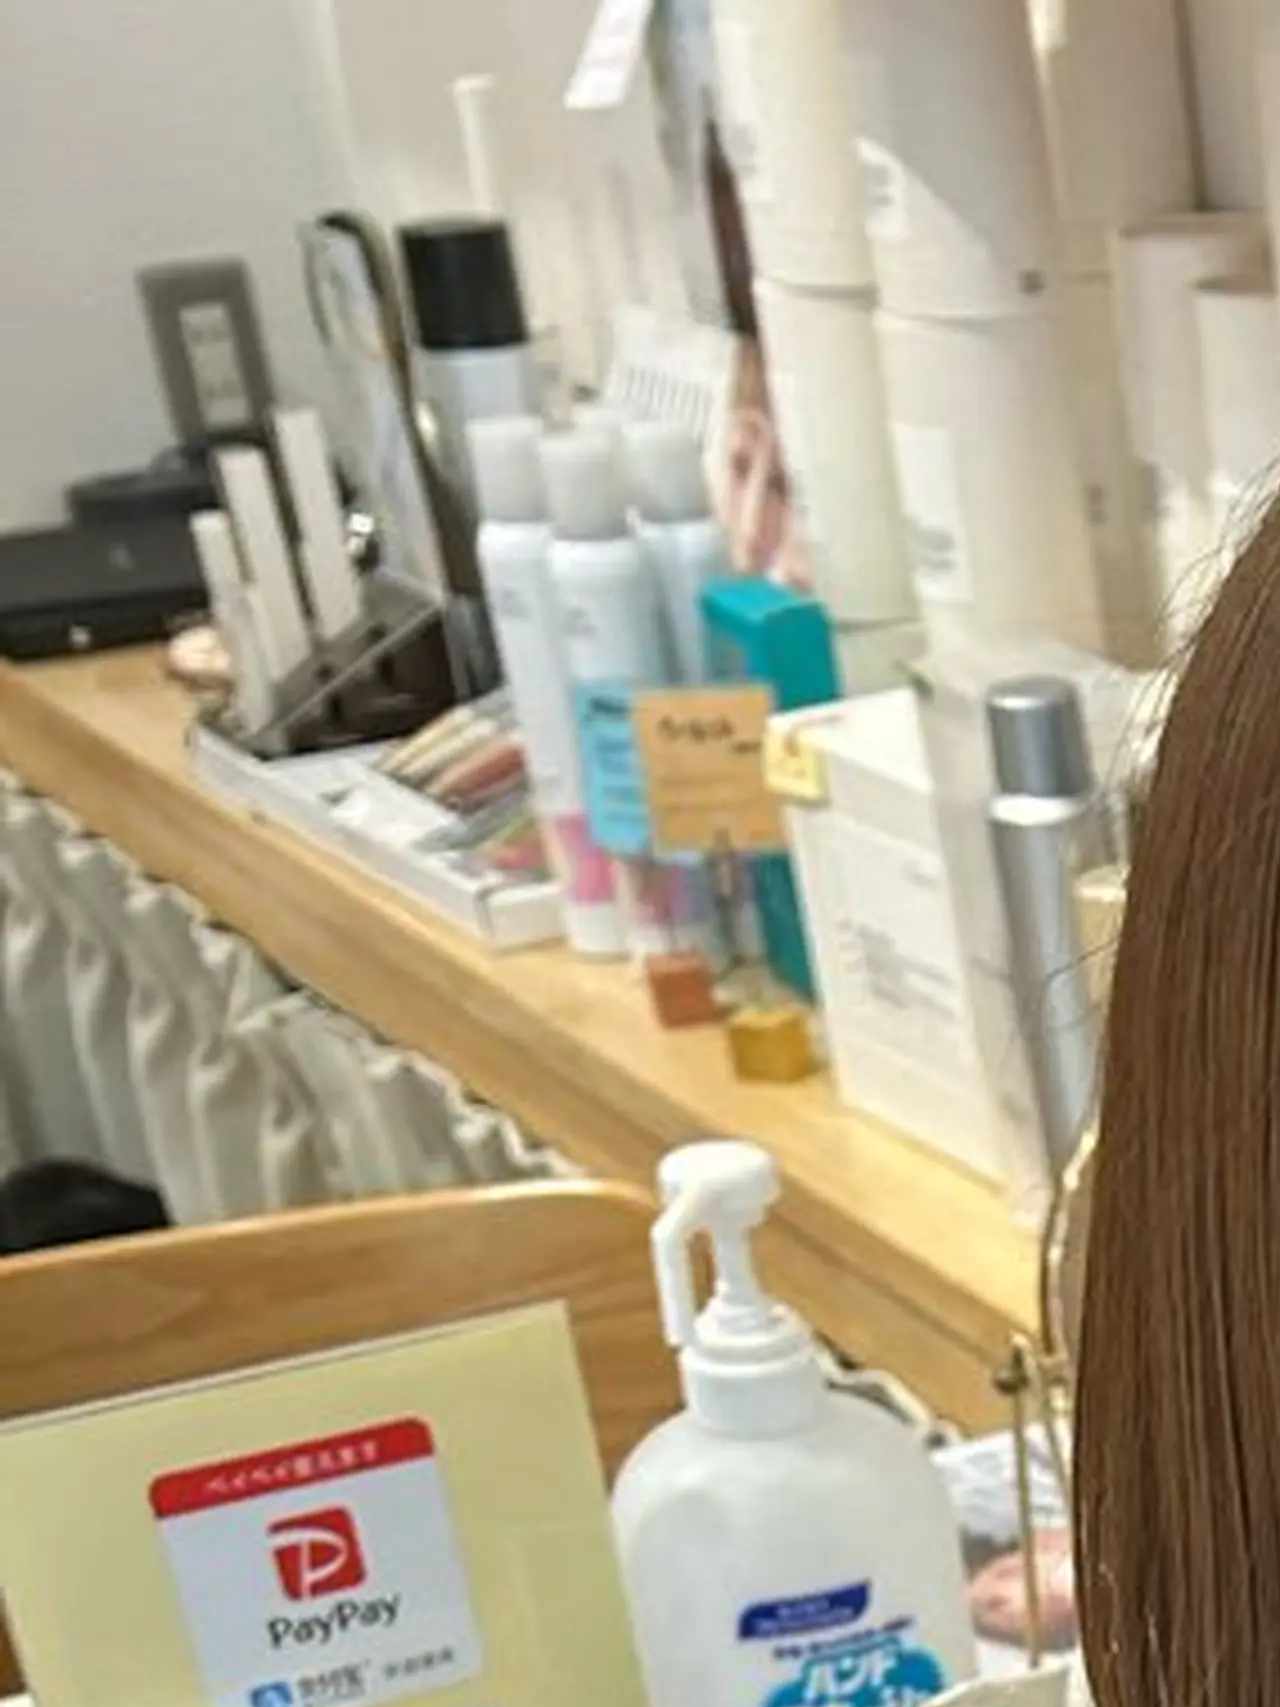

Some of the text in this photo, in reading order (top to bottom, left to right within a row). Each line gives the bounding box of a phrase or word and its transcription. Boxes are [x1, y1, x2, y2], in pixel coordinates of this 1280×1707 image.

[266, 1594, 401, 1650] PayPay
[803, 1650, 898, 1699] ハンド
